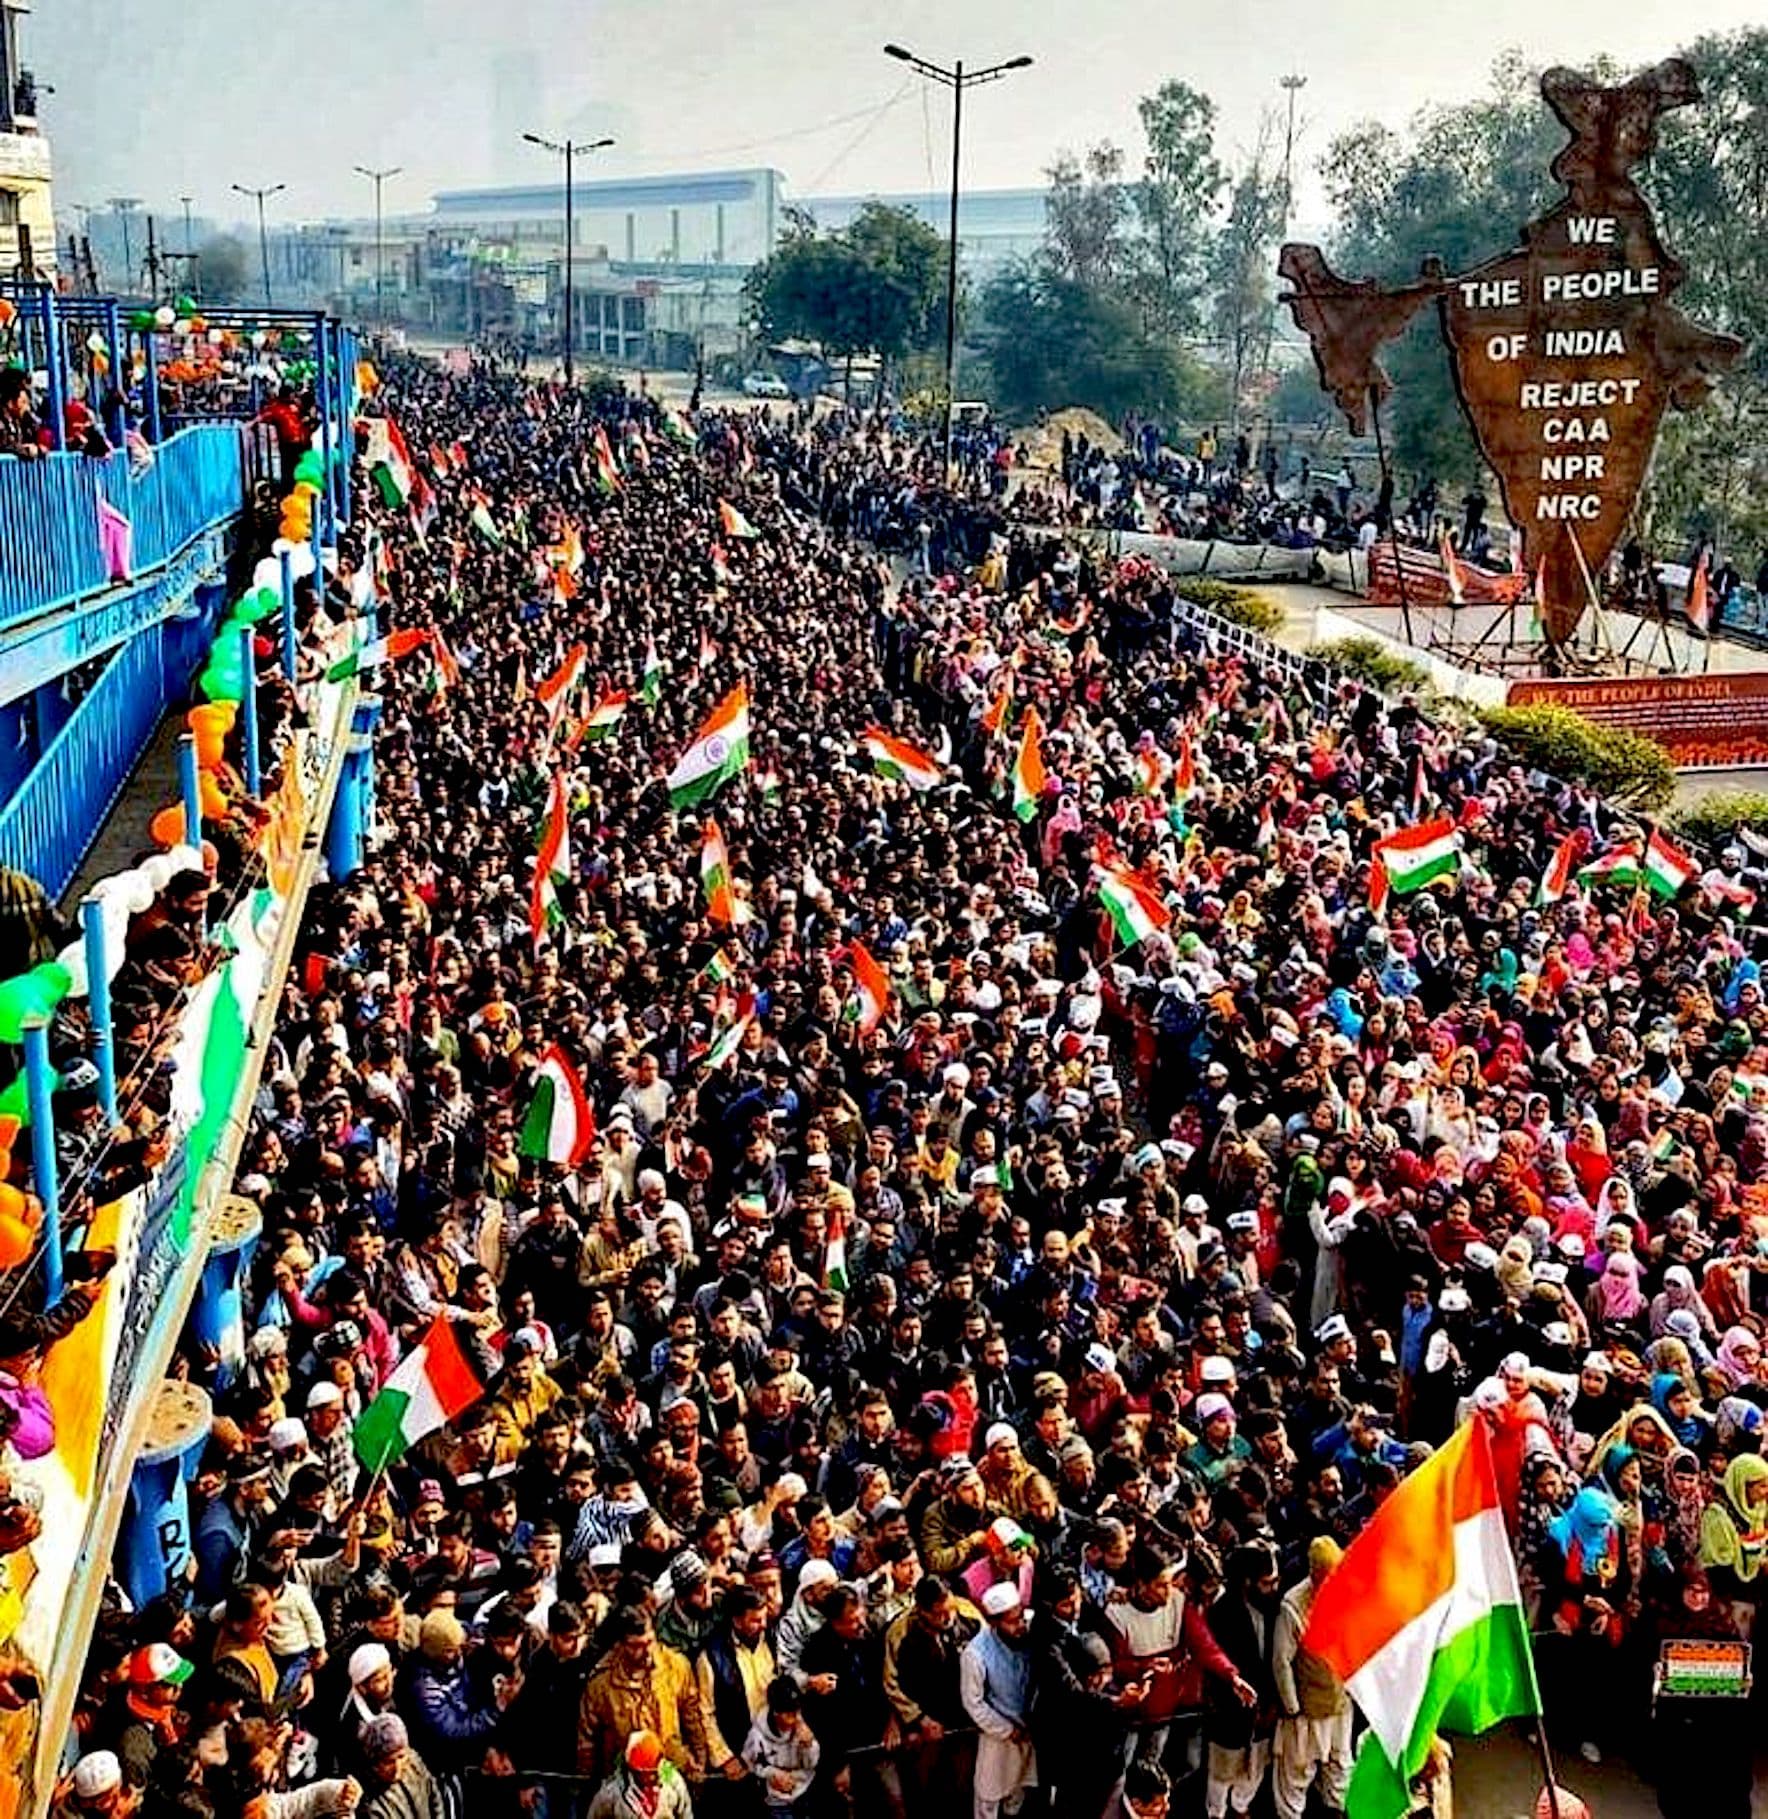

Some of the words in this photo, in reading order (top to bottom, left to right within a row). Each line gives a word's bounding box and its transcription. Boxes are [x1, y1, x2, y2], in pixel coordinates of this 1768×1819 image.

[1568, 217, 1616, 244] WE
[1459, 281, 1521, 308] THE
[1543, 268, 1659, 301] PEOPLE
[1487, 334, 1528, 361] OF
[1545, 330, 1625, 356] INDIA
[1520, 379, 1640, 409] REJECT
[1543, 418, 1610, 443] CAA
[1541, 455, 1605, 481] NPR
[1536, 494, 1601, 519] NRC
